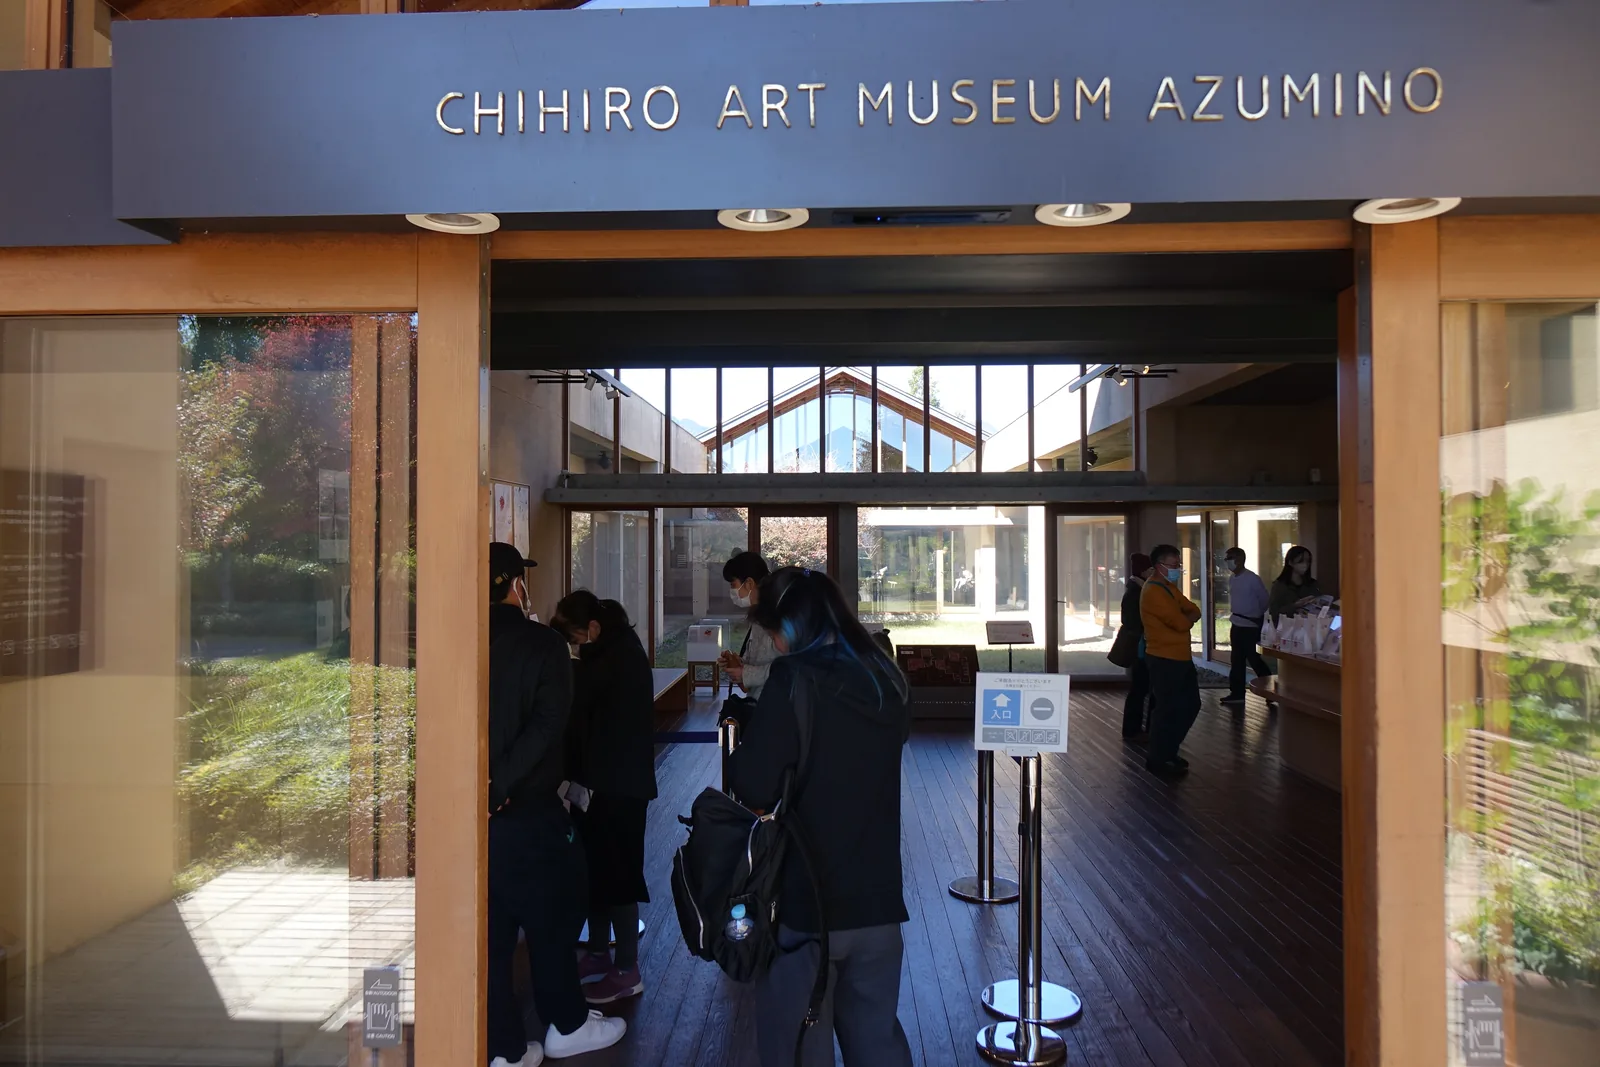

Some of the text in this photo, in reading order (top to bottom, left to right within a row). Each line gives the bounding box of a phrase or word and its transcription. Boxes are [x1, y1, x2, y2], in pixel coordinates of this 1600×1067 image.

[435, 66, 1444, 136] CHIHIRO ART MUSEUM AZUMINO
[990, 709, 1012, 720] 入口
